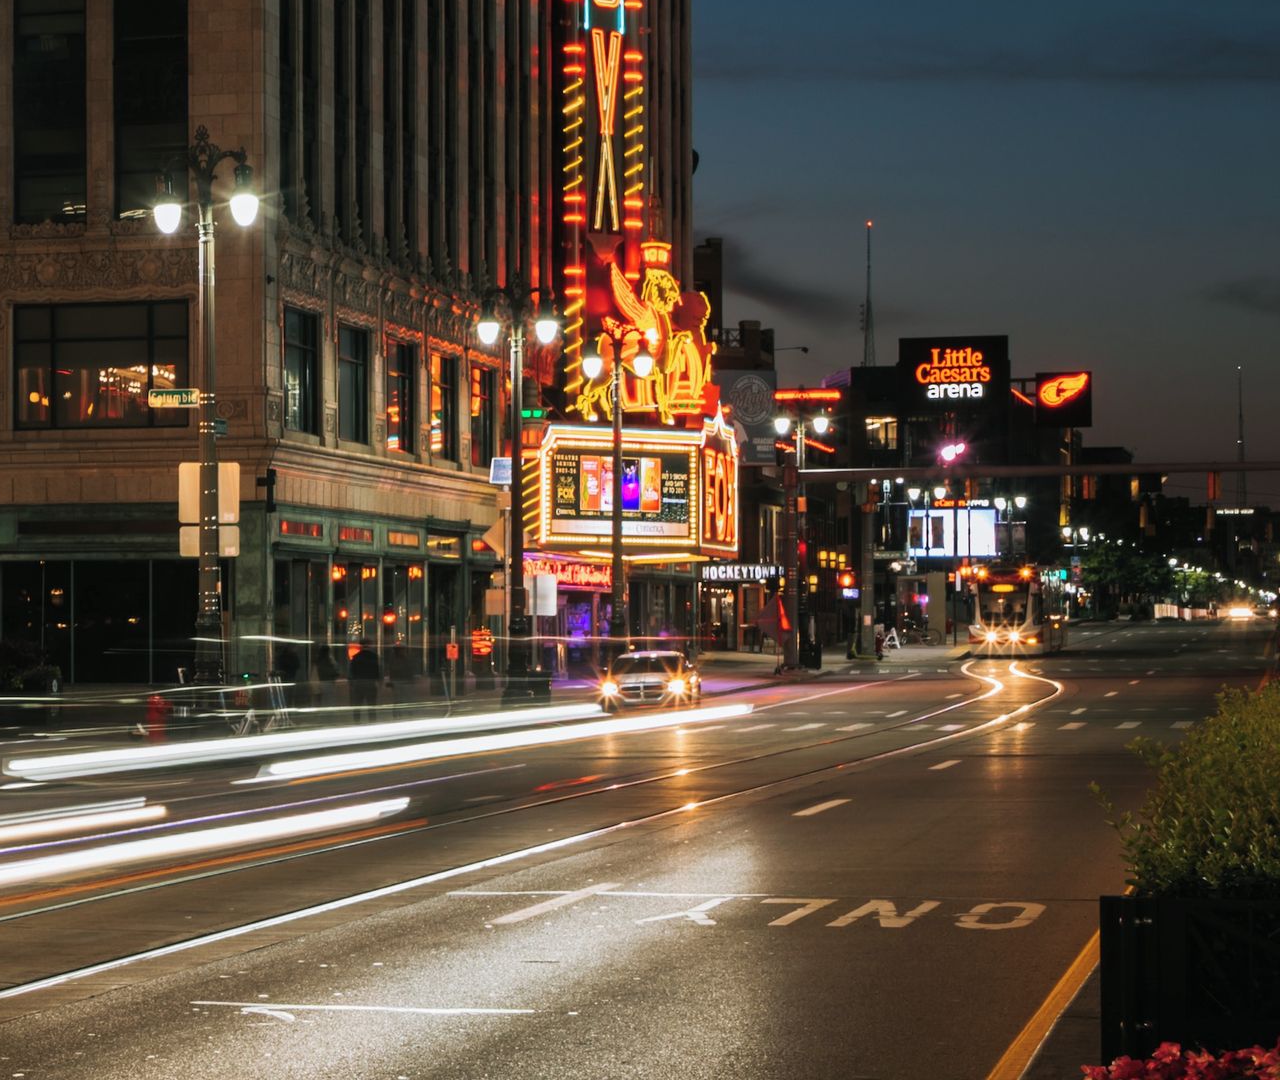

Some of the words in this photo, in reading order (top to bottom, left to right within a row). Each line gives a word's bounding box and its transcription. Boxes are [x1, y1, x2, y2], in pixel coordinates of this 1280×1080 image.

[930, 347, 983, 368] Little
[915, 363, 991, 384] Caesars
[151, 392, 198, 403] Columbia
[927, 382, 984, 399] arena
[704, 448, 736, 542] FOX
[702, 565, 776, 580] HOCKEYTOWN
